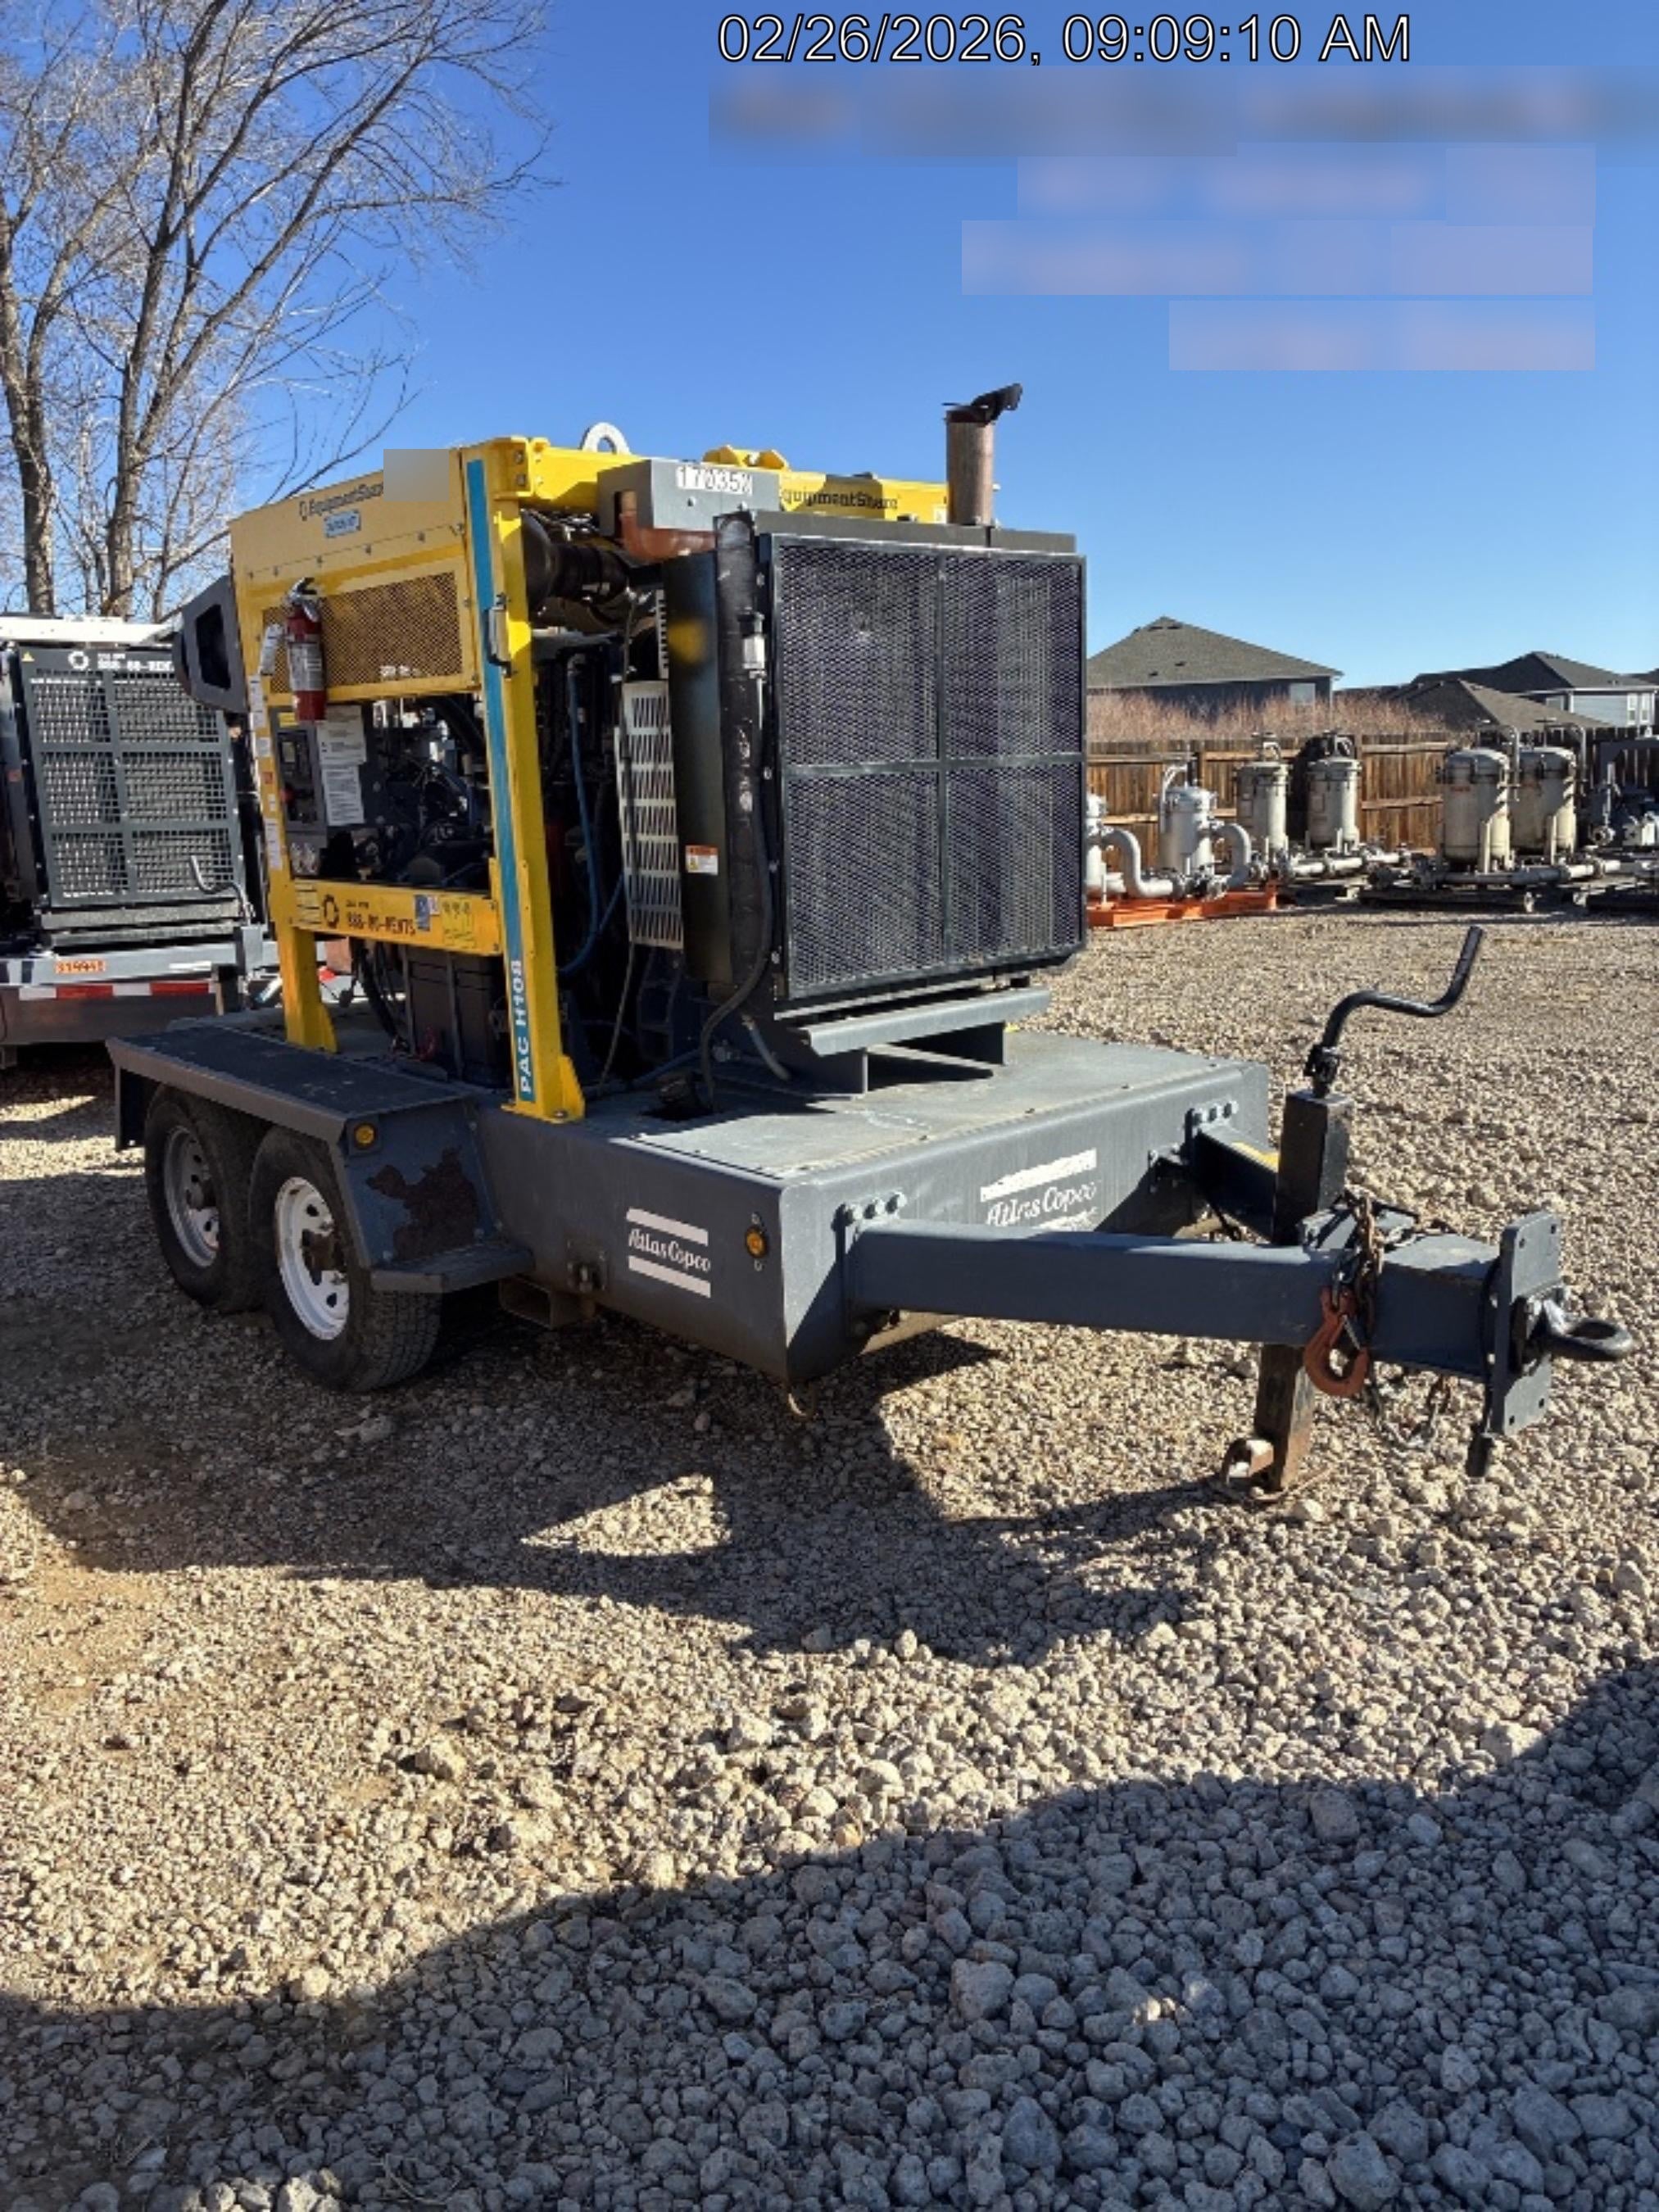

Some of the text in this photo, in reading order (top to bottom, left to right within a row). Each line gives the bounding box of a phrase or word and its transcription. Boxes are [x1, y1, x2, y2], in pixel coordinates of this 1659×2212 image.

[781, 487, 899, 510] quipmentShare
[518, 1036, 531, 1094] PAC
[986, 1199, 1041, 1227] Atlas
[628, 1228, 710, 1273] Atlas Copco
